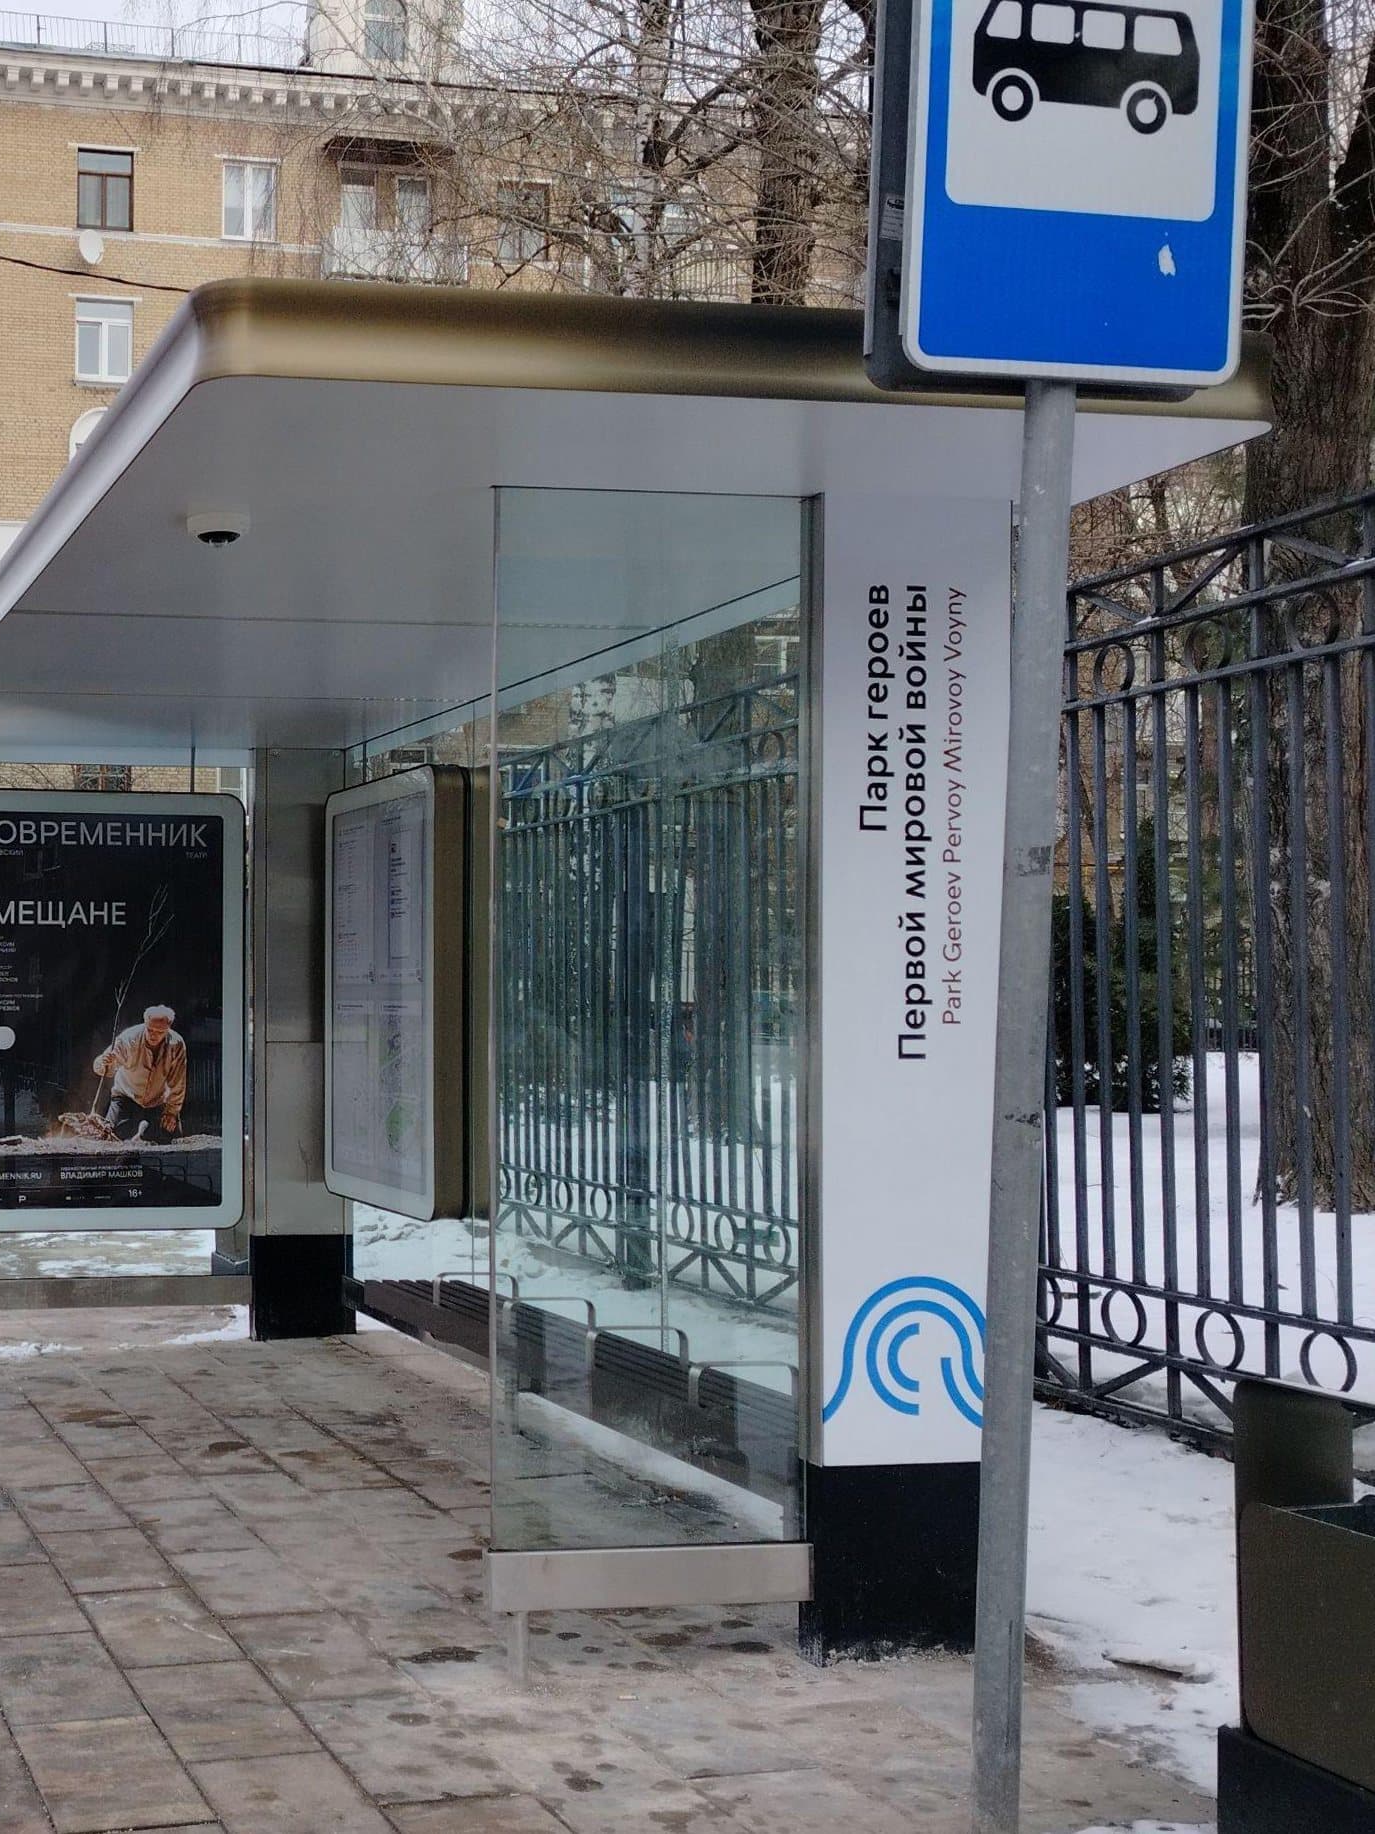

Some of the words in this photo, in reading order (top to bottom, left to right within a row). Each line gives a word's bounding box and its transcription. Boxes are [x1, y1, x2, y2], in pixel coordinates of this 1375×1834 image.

[867, 584, 895, 719] героев
[898, 585, 927, 710] войны
[943, 587, 967, 662] Voyny
[943, 668, 967, 773] Mirovoy
[859, 731, 895, 831] Парк
[897, 724, 932, 899] мировой
[942, 779, 967, 863] Pervoy
[942, 871, 962, 962] Geroev
[898, 911, 933, 1060] Первой
[941, 969, 962, 1025] Park
